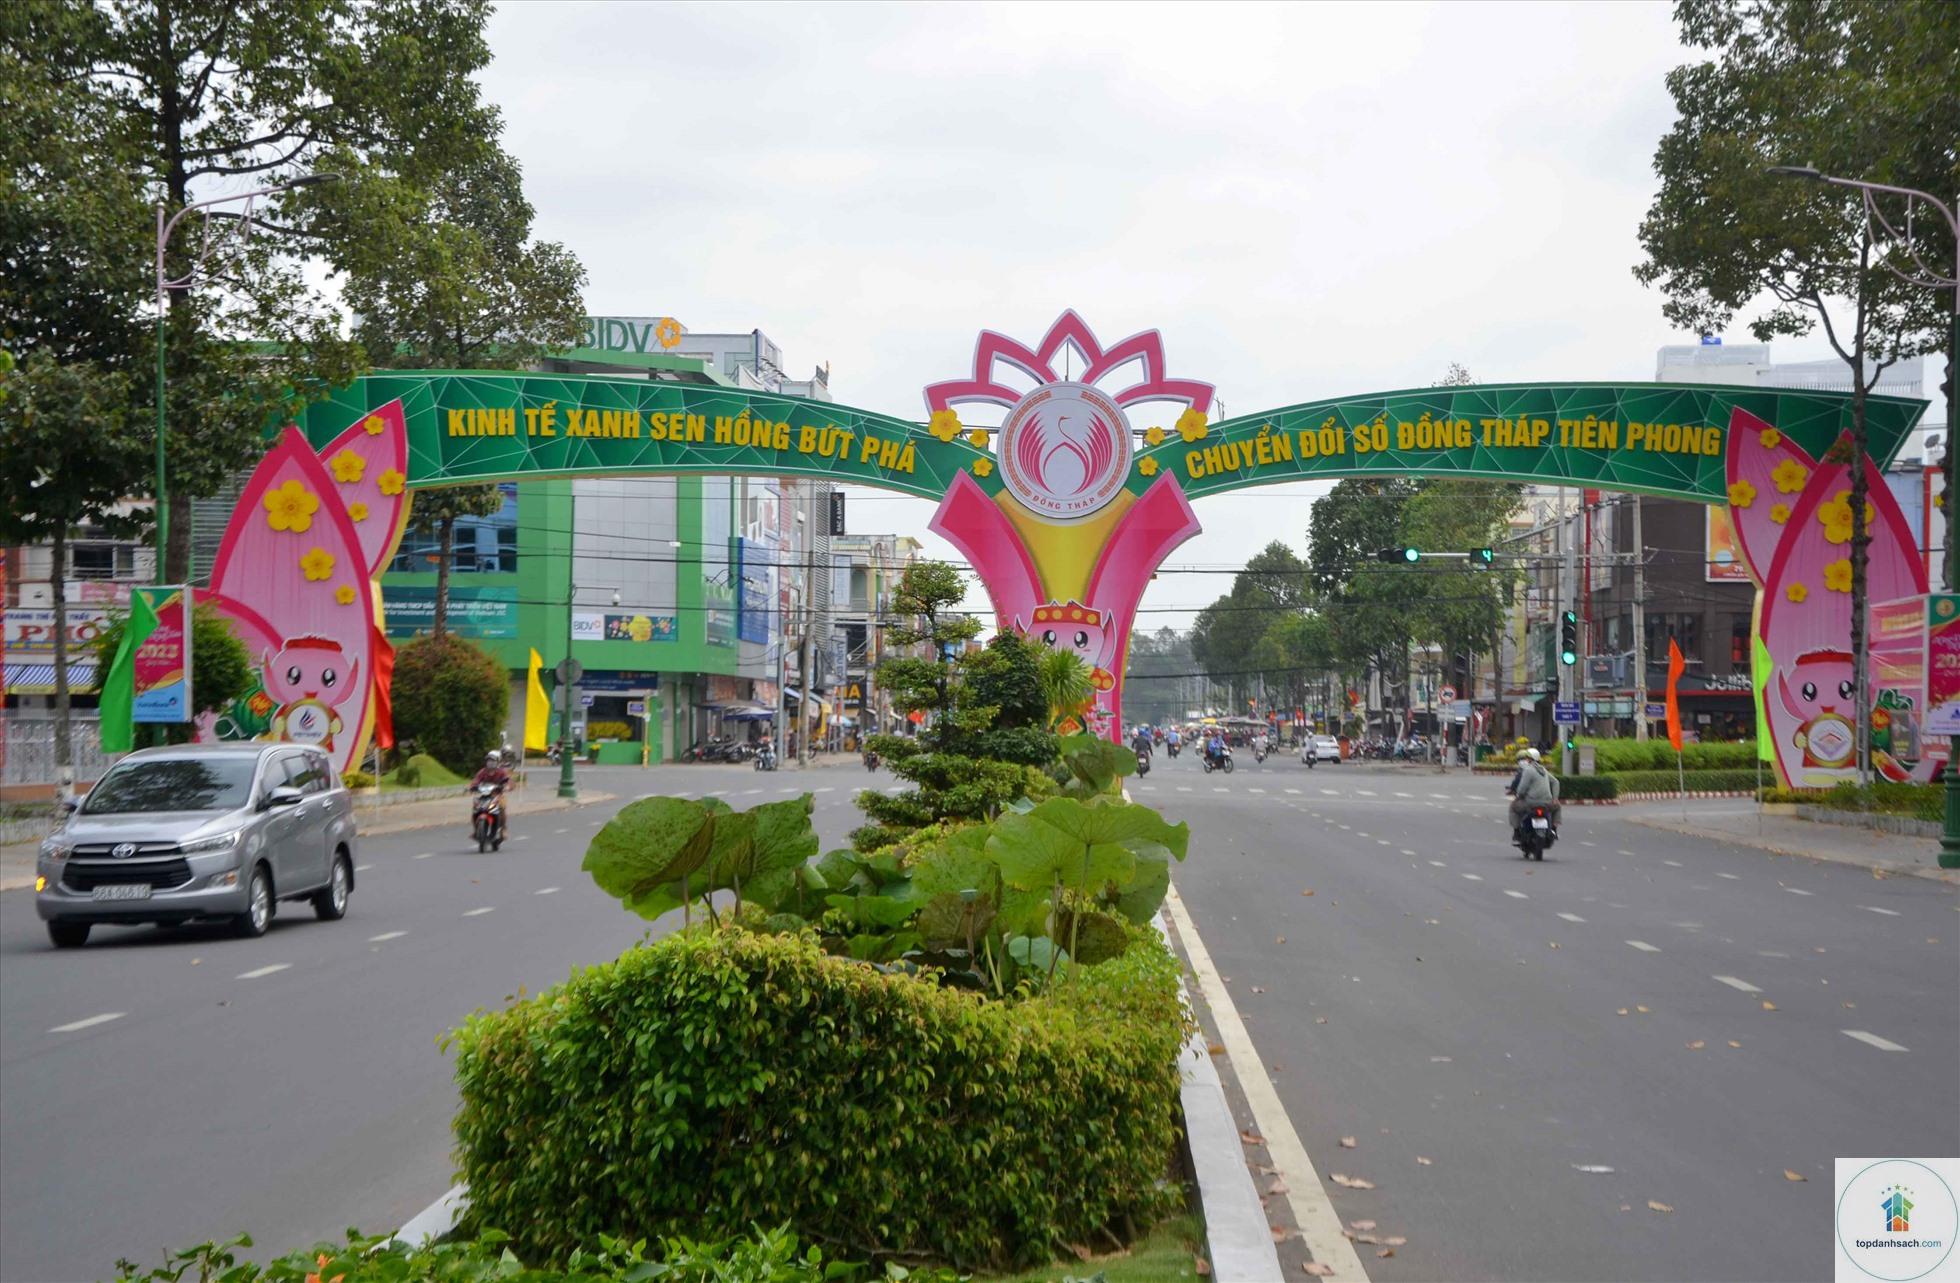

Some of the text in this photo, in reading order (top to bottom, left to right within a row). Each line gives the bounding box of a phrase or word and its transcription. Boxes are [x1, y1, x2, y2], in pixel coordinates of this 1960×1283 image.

[578, 317, 653, 352] BIDV
[448, 400, 916, 474] KINH TẾ XANH SEN HỒNG BỨT PHÁ
[1185, 411, 1721, 480] CHUYỂN ĐỔI SỐ ĐỒNG THÁP TIÊN PHONG
[1705, 674, 1752, 691] Jollib
